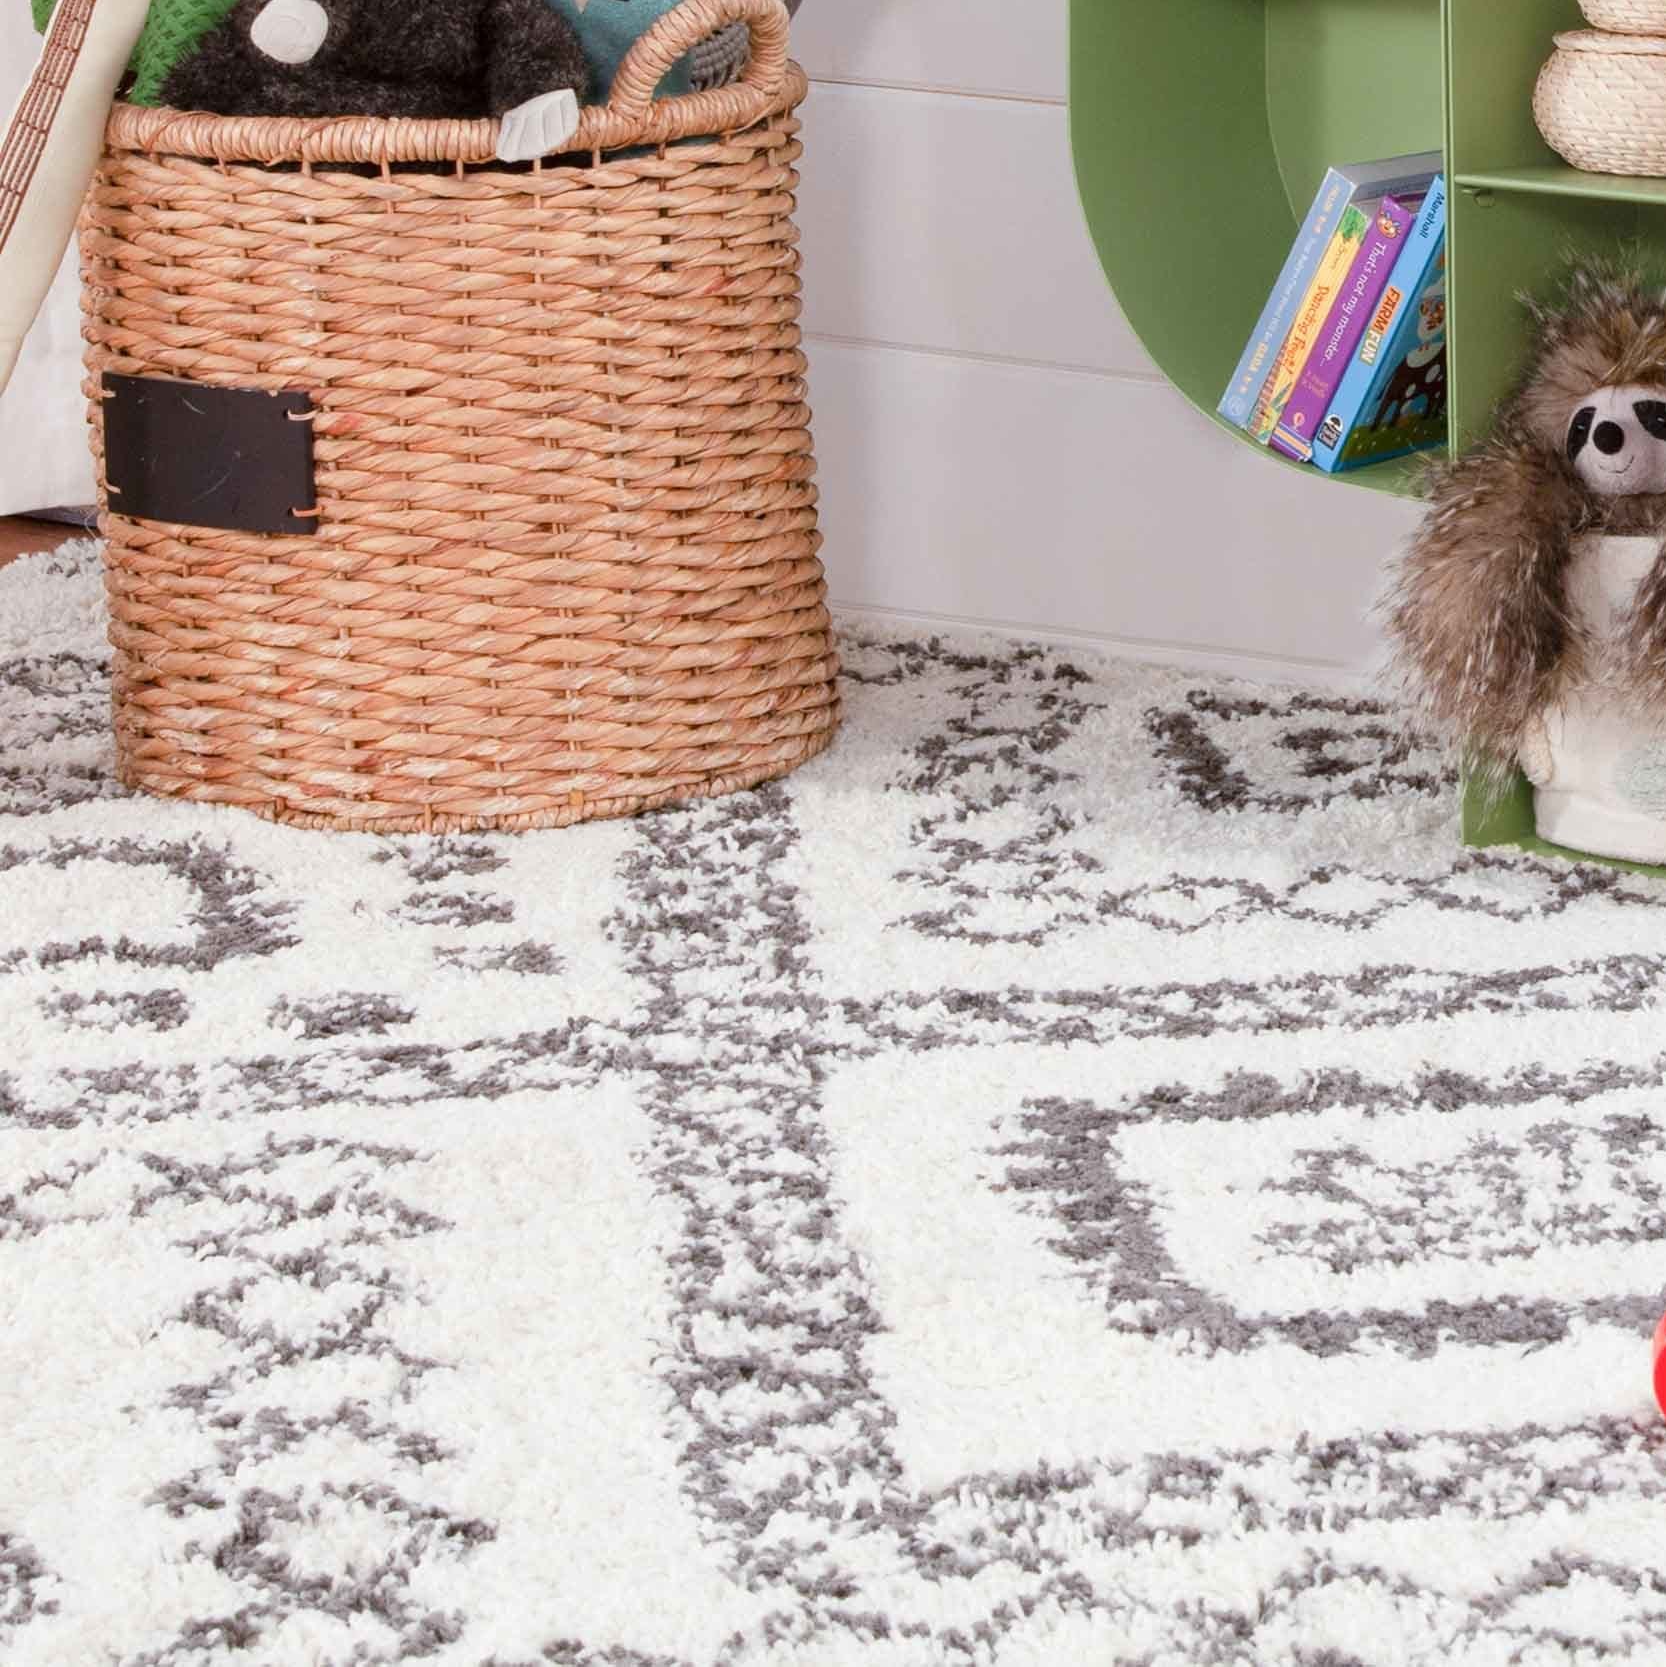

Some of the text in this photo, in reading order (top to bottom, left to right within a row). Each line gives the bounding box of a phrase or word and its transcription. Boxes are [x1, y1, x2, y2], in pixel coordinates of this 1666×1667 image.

[1420, 192, 1445, 238] Marshall
[1366, 241, 1387, 275] That's
[1342, 292, 1361, 314] my
[1357, 276, 1369, 297] not
[1298, 285, 1330, 335] Dancing
[1361, 286, 1401, 364] FARM FUN
